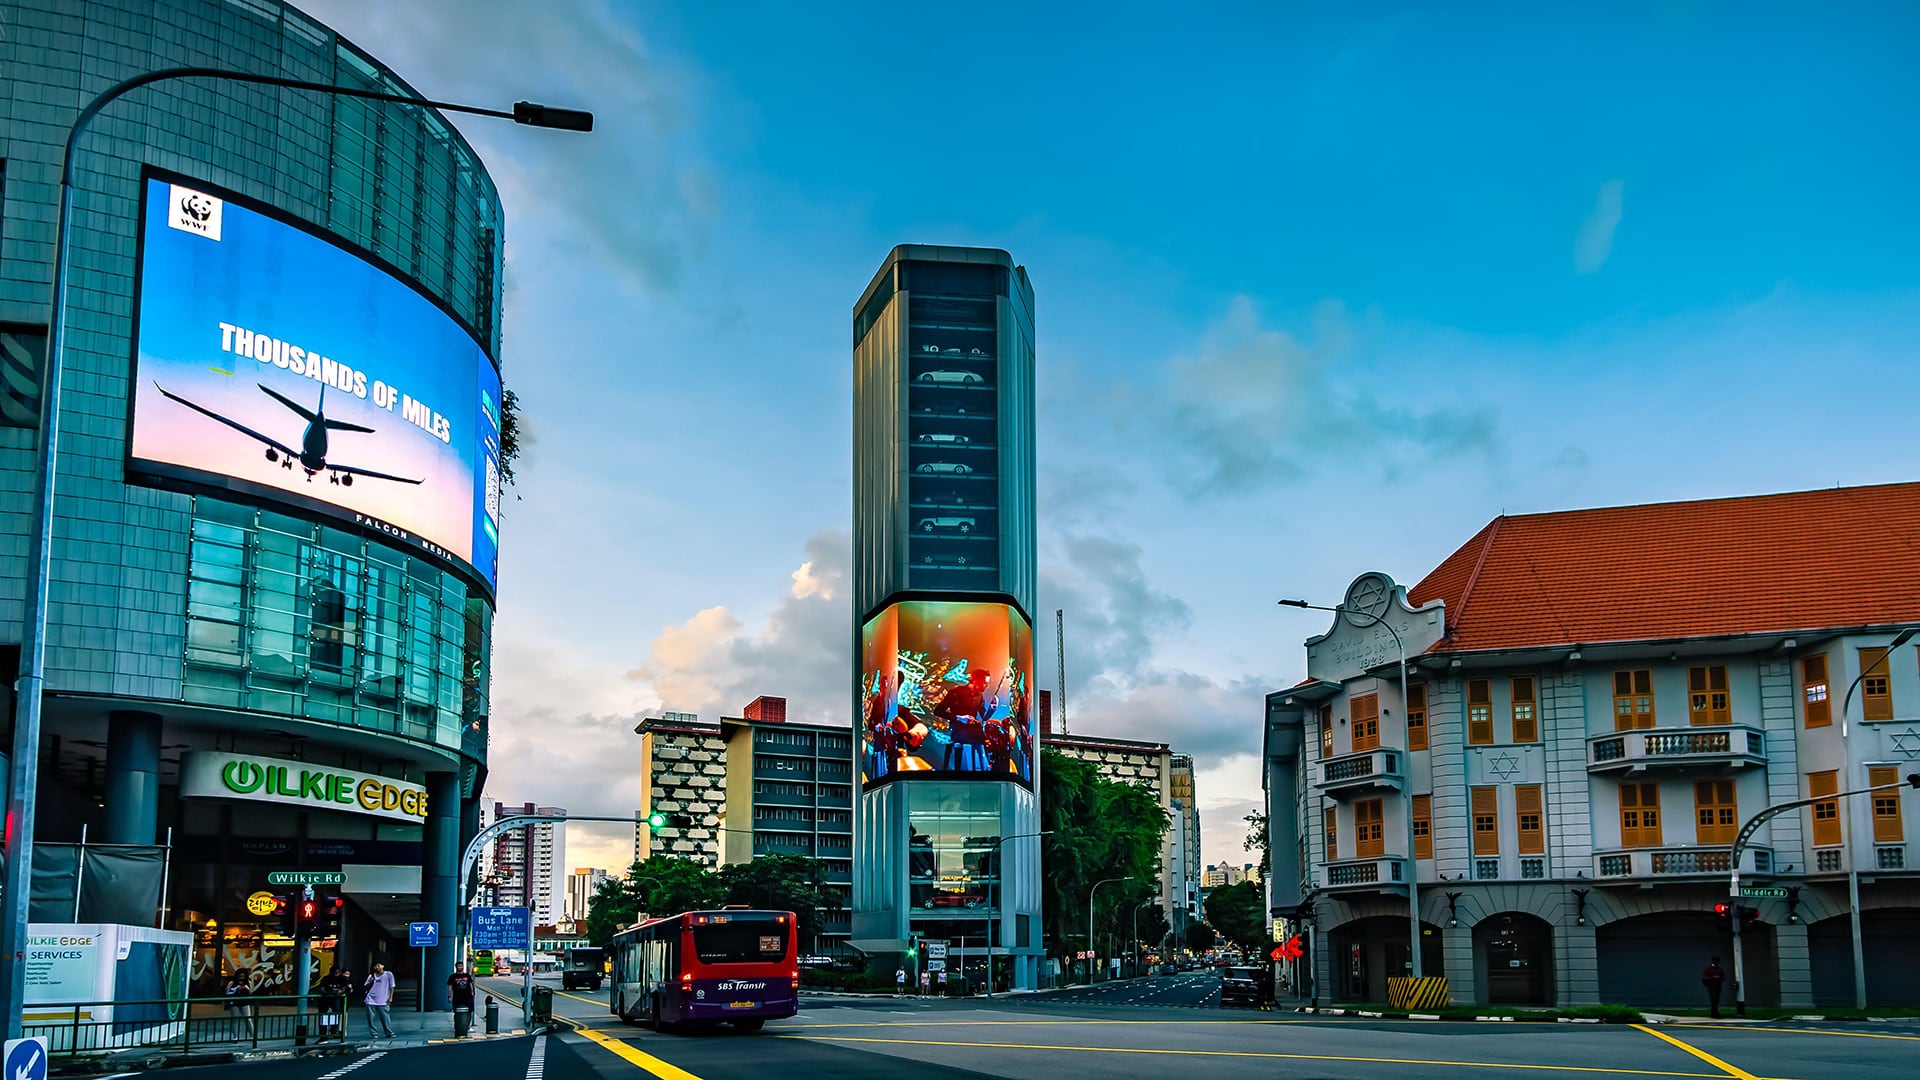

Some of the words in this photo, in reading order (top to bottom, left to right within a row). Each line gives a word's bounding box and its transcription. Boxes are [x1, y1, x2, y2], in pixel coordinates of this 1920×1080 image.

[181, 218, 210, 231] WWF
[219, 321, 367, 399] THOUSANDS
[373, 380, 398, 412] OF
[402, 393, 450, 444] MILES
[356, 514, 407, 539] FALCON
[422, 540, 452, 560] MEDIA
[276, 874, 320, 882] Wilkie
[325, 874, 341, 882] Rd
[478, 916, 496, 924] Bus
[500, 916, 523, 924] Lane
[31, 951, 82, 960] SERVICES
[717, 982, 733, 991] SBS
[728, 979, 767, 991] Transit
